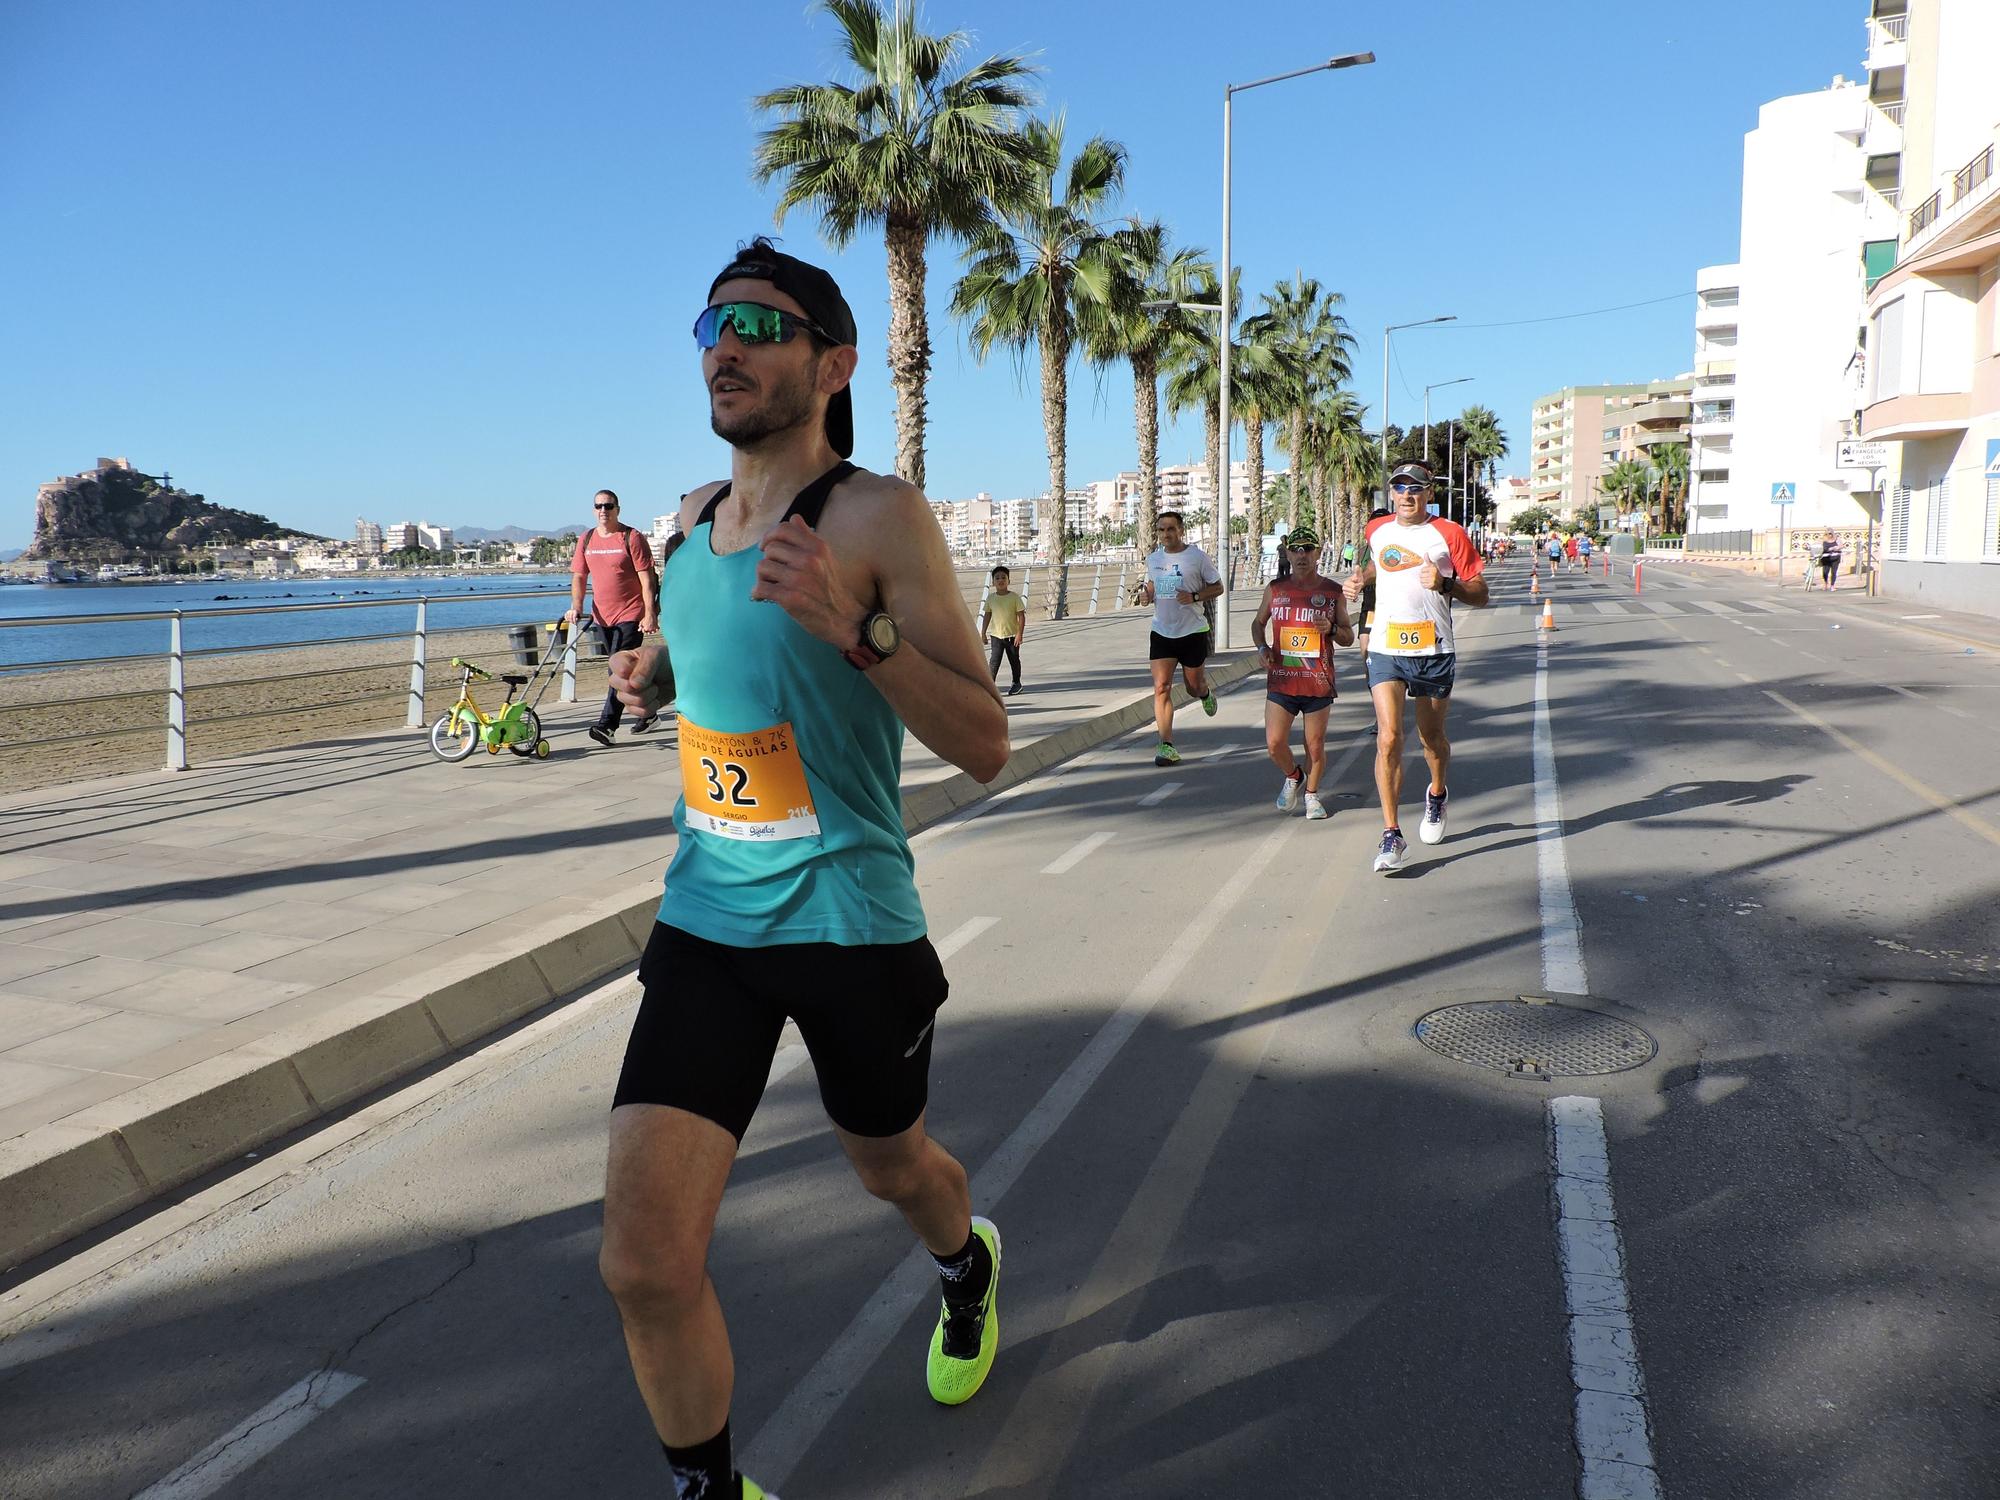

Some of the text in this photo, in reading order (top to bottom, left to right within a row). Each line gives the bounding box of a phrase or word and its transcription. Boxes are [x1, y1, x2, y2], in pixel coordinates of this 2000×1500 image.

[1291, 635, 1308, 648] 87
[1400, 631, 1419, 645] 96
[753, 737, 762, 746] &
[769, 728, 786, 741] 7K
[711, 745, 724, 756] DE
[701, 757, 758, 806] 32
[723, 811, 748, 820] SERGIO
[787, 806, 810, 819] 21K
